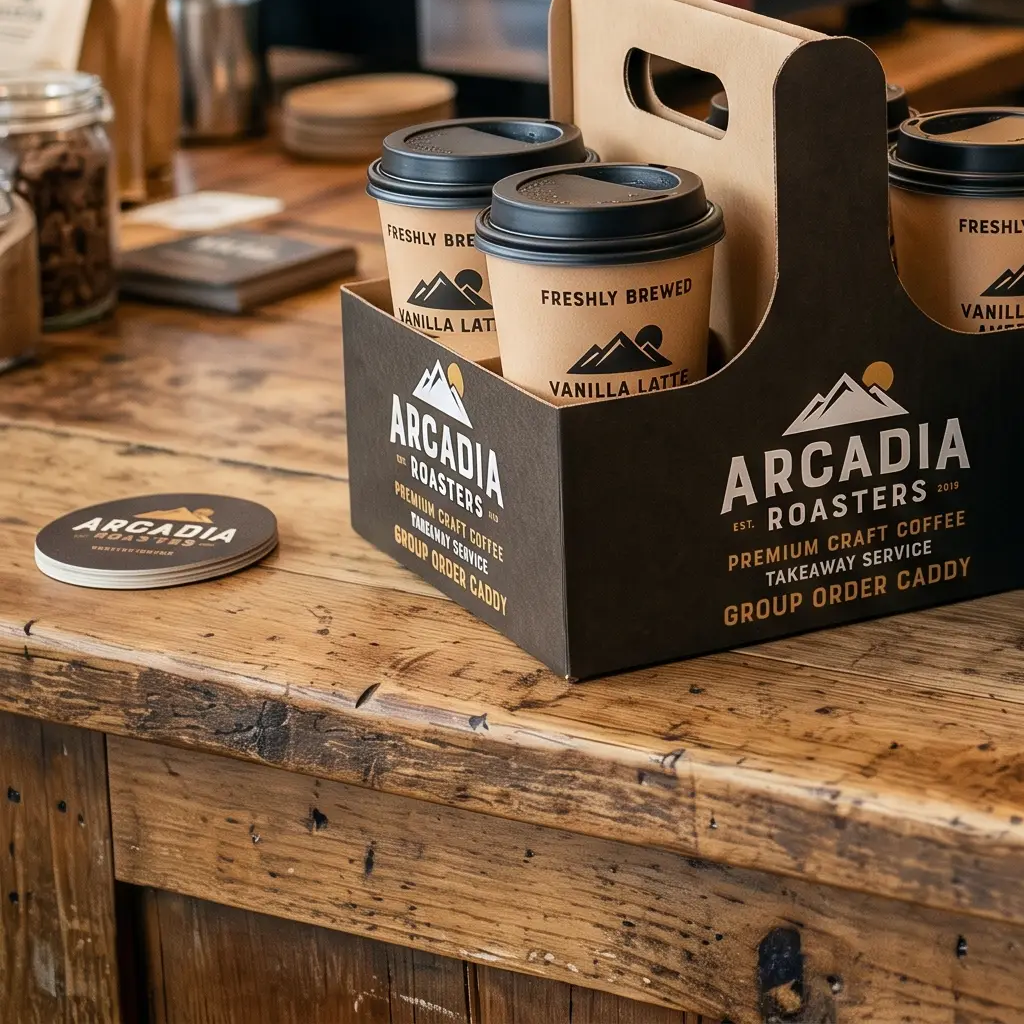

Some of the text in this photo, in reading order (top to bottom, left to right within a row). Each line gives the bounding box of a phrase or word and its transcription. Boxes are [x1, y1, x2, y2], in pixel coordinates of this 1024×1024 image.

[387, 224, 476, 248] FRESHLY BRE
[541, 278, 692, 306] FRESHLY BREWED
[398, 307, 454, 333] VANILLA
[548, 368, 689, 398] VANILLA LATTE
[390, 392, 504, 510] ARCADIA
[720, 417, 970, 516] ARCADIA
[410, 454, 484, 518] ROASTERS
[732, 479, 960, 532] EST. ROASTERS 2019
[72, 516, 237, 544] ARCADIA
[394, 480, 504, 562] PREMIUM CRAFT COFFEE
[728, 510, 966, 572] PREMIUM CRAFT COFFEE
[394, 524, 508, 616] GROUP ORDER CADDY
[452, 538, 489, 575] SERVICE
[766, 540, 932, 587] TAKEAWAY SERVICE
[724, 556, 972, 626] GROUP ORDER CADDY
